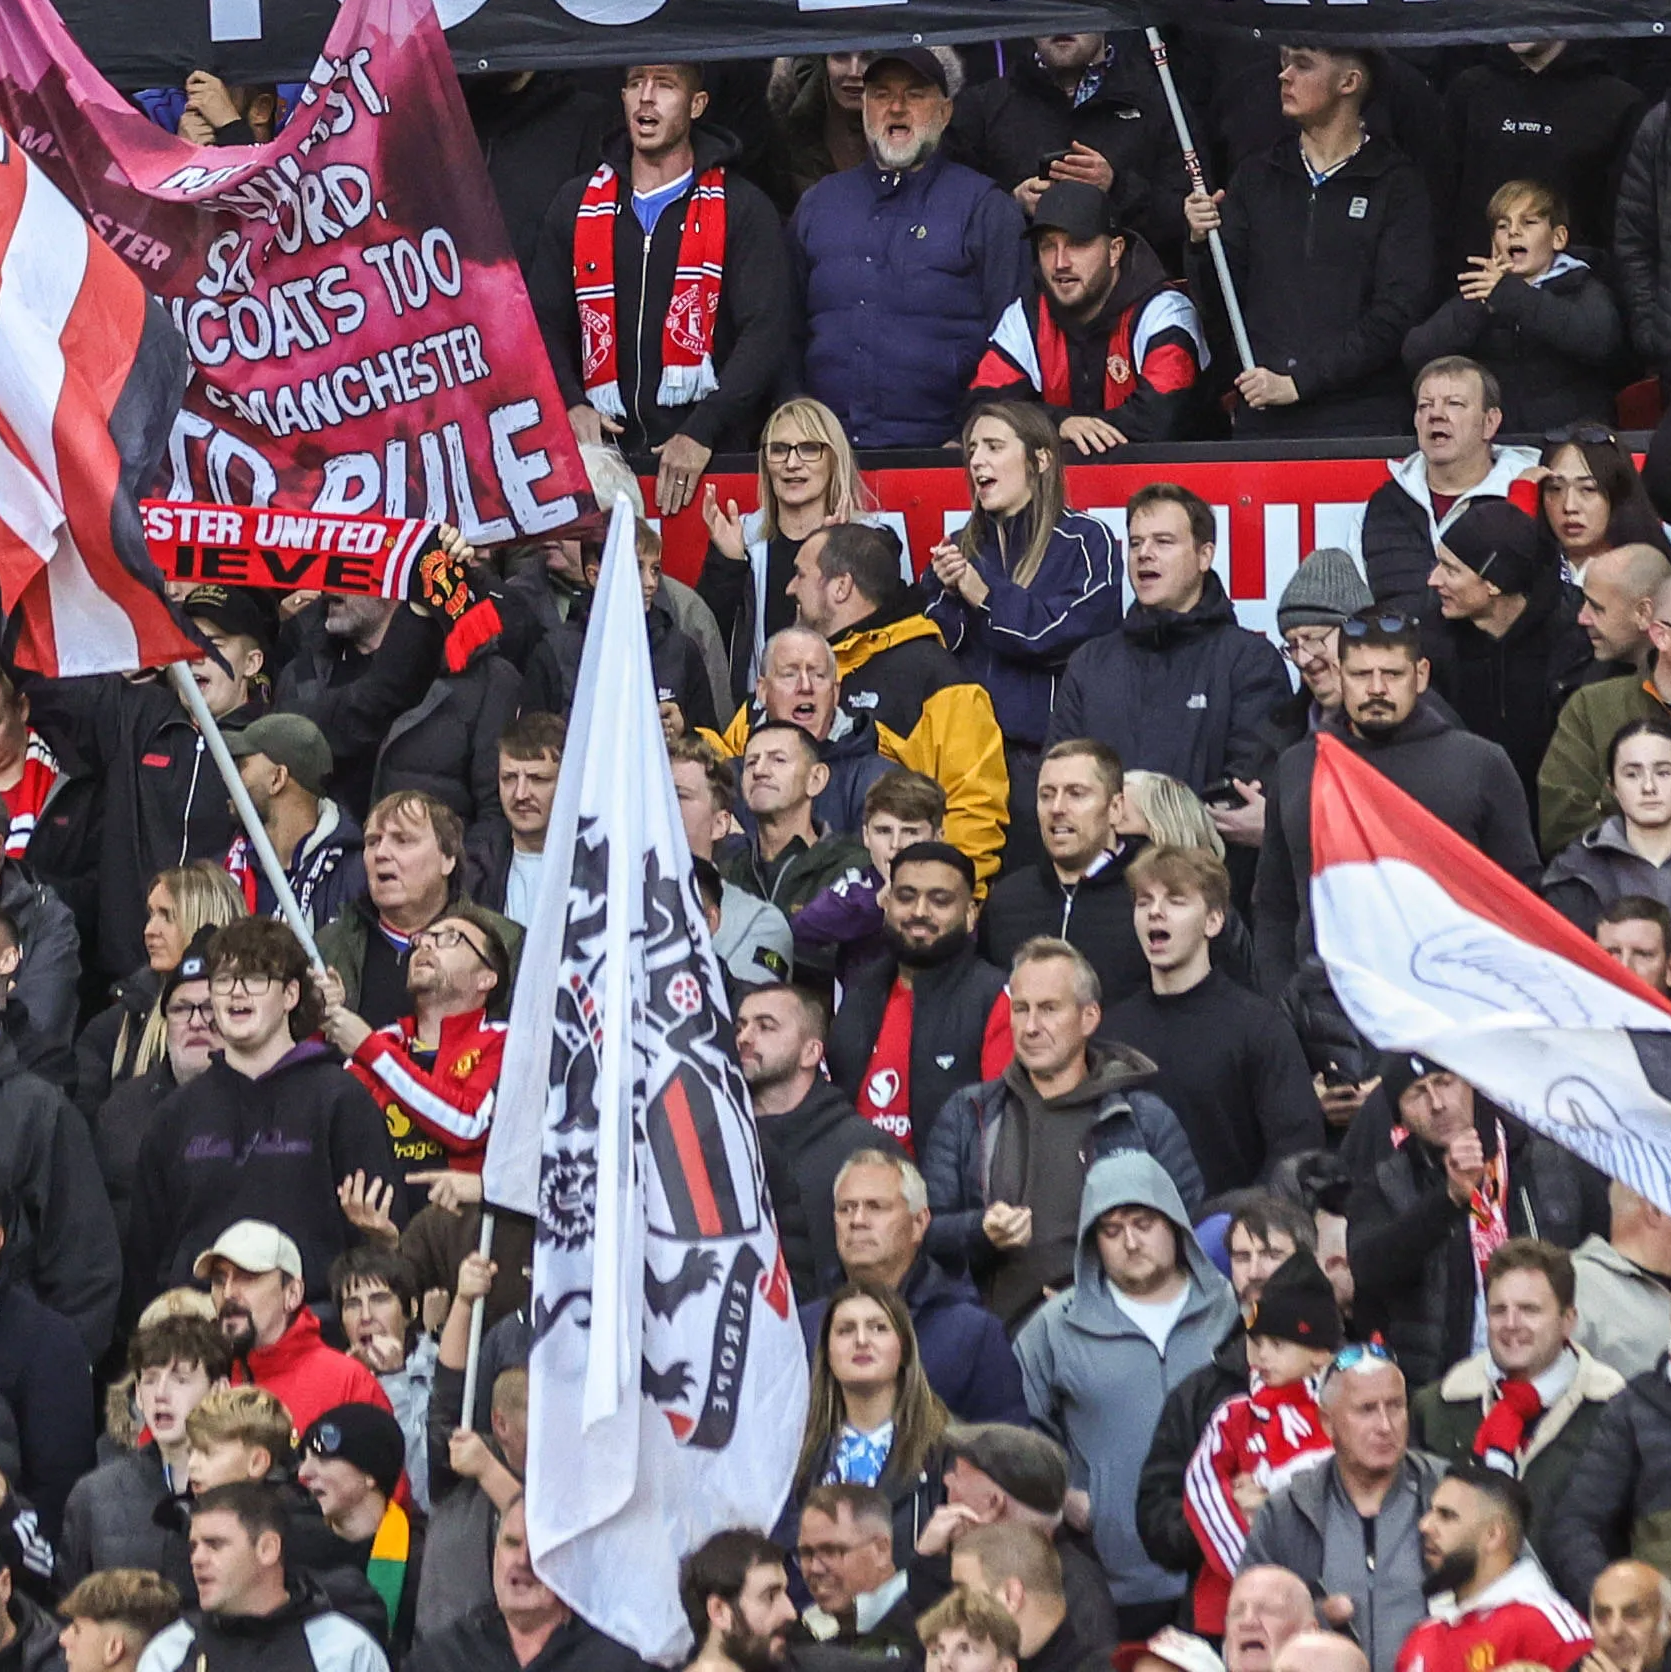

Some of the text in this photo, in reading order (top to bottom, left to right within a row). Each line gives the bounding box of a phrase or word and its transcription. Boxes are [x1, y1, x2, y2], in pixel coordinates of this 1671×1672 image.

[363, 225, 463, 317] TOO
[230, 325, 492, 439] MANCHESTER
[164, 545, 378, 594] IEVE
[254, 513, 388, 556] UNITED
